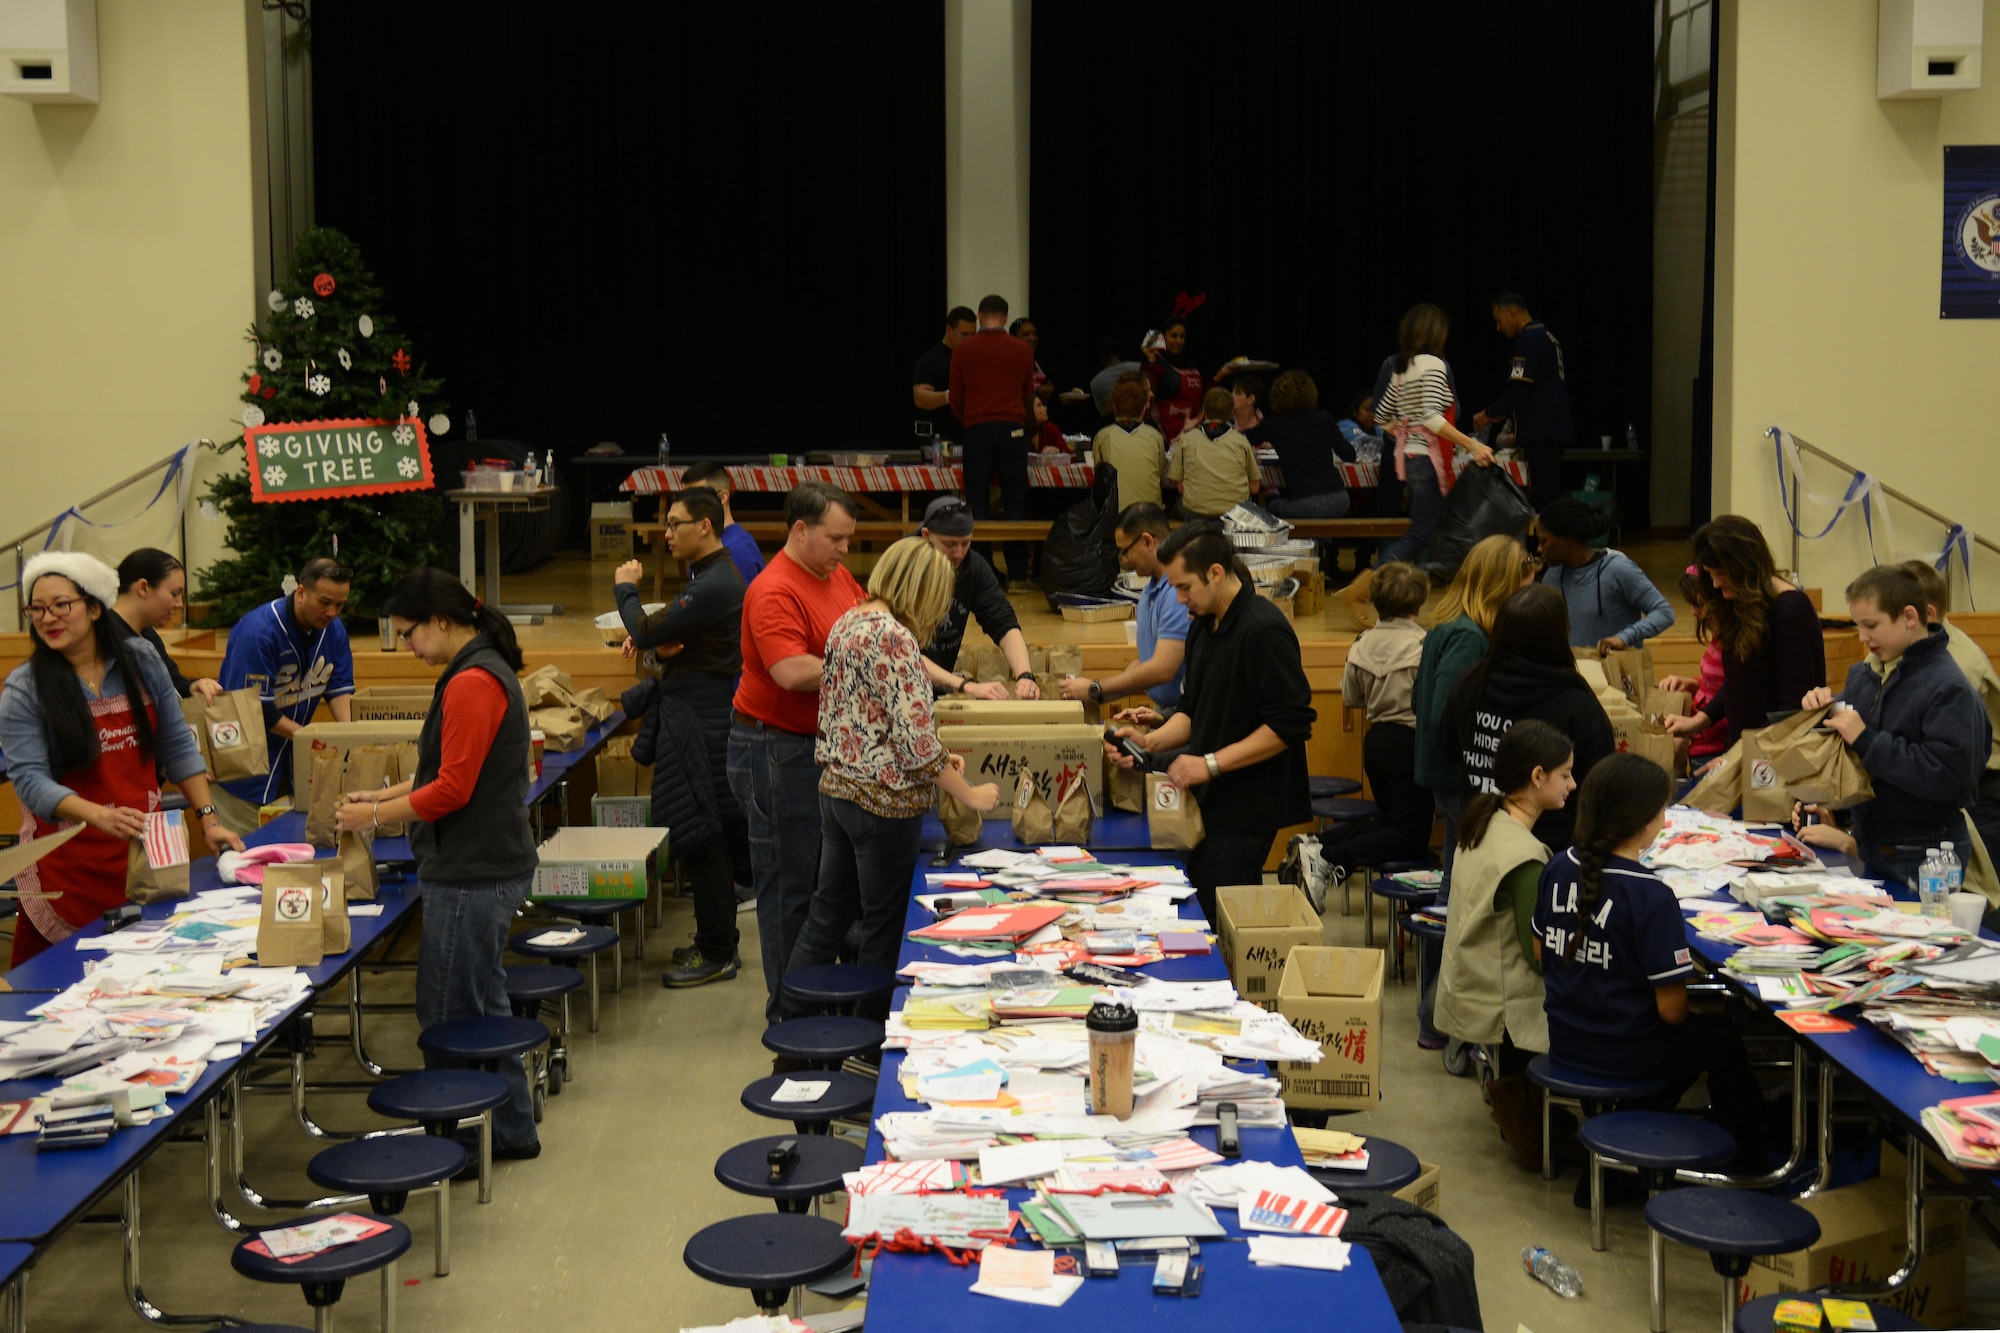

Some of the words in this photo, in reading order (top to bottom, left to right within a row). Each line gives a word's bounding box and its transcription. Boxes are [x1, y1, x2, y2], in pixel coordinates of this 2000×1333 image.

[284, 430, 383, 459] GIVING
[303, 457, 375, 484] TREE
[1476, 711, 1501, 731] YOU
[1473, 731, 1501, 752] HIDE
[1343, 1028, 1368, 1065] 情
